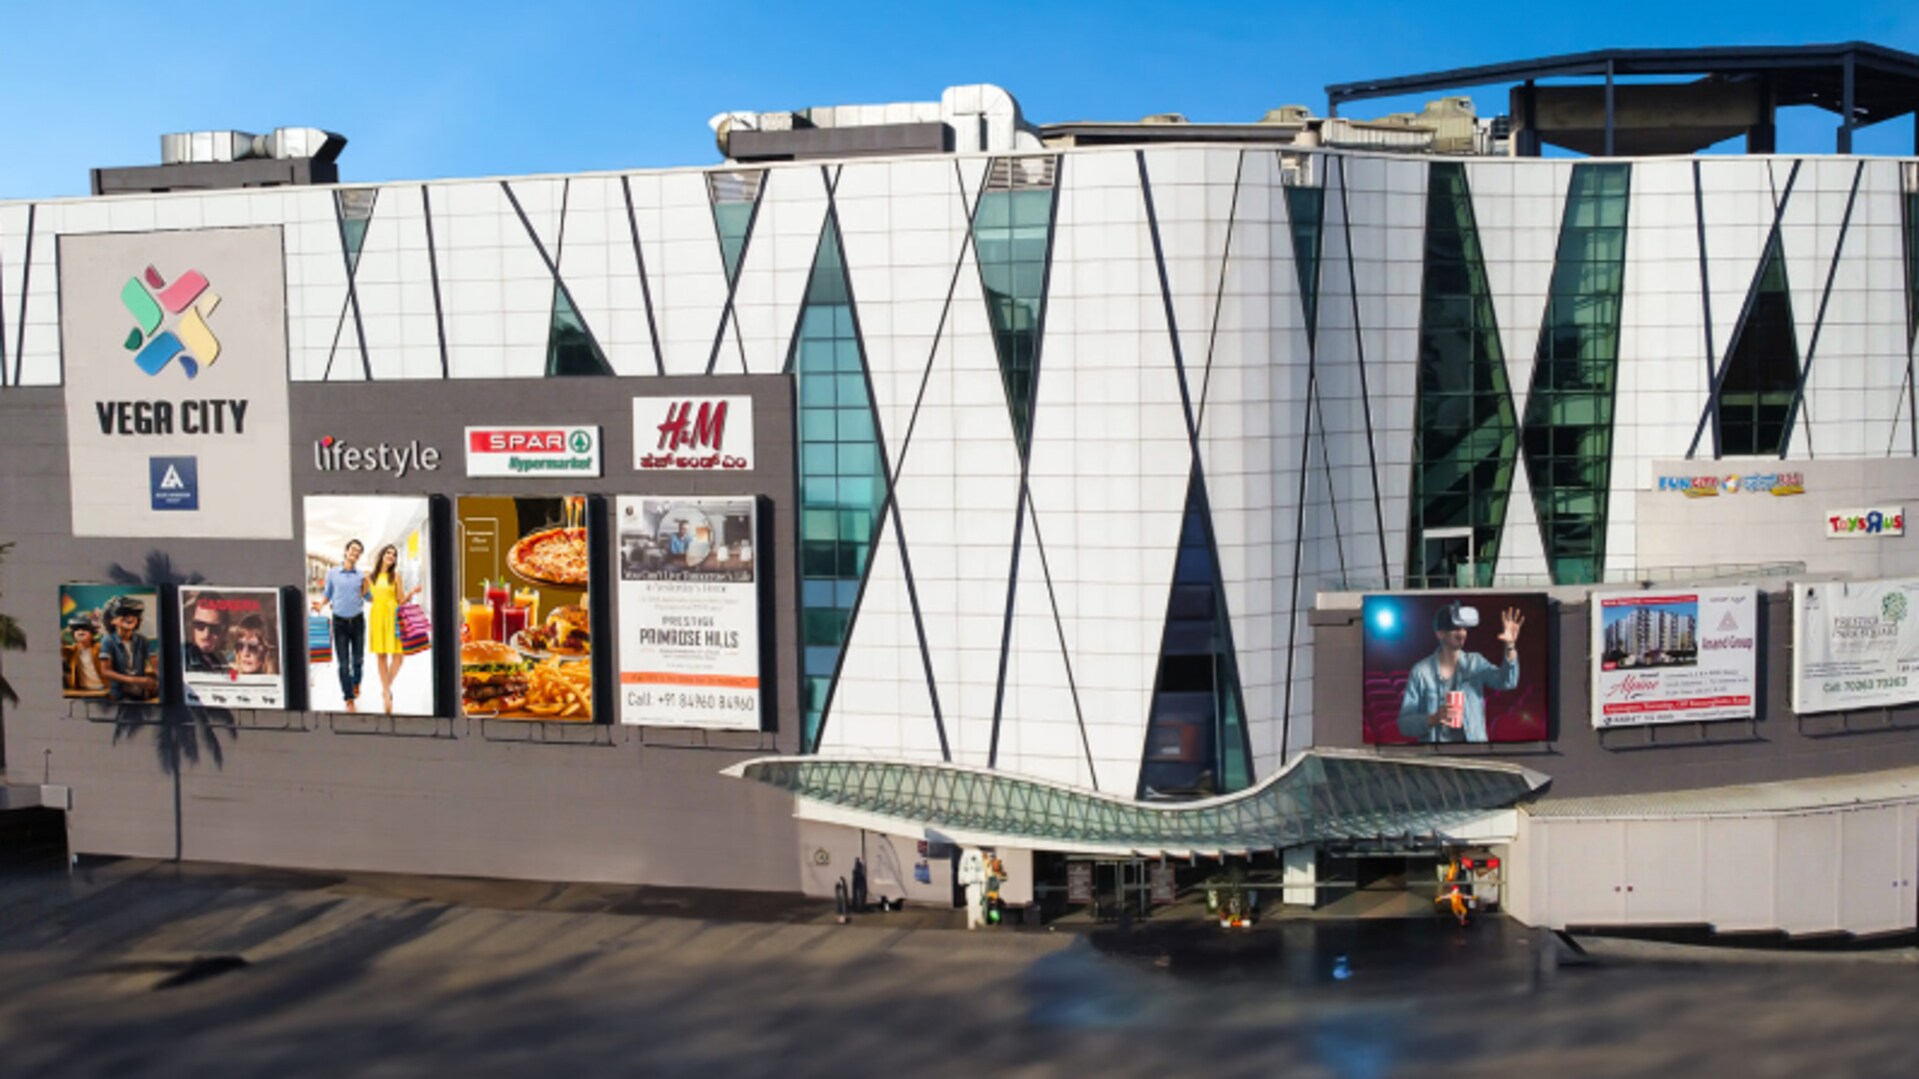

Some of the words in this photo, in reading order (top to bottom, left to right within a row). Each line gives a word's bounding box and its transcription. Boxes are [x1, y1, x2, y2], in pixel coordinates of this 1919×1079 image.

[96, 401, 174, 434] VEGA
[180, 400, 249, 434] CITY
[657, 400, 728, 451] H&M
[489, 433, 564, 450] SPAR
[314, 435, 440, 478] lifestyle
[508, 456, 592, 472] Hypermarket
[705, 630, 739, 649] HILLS
